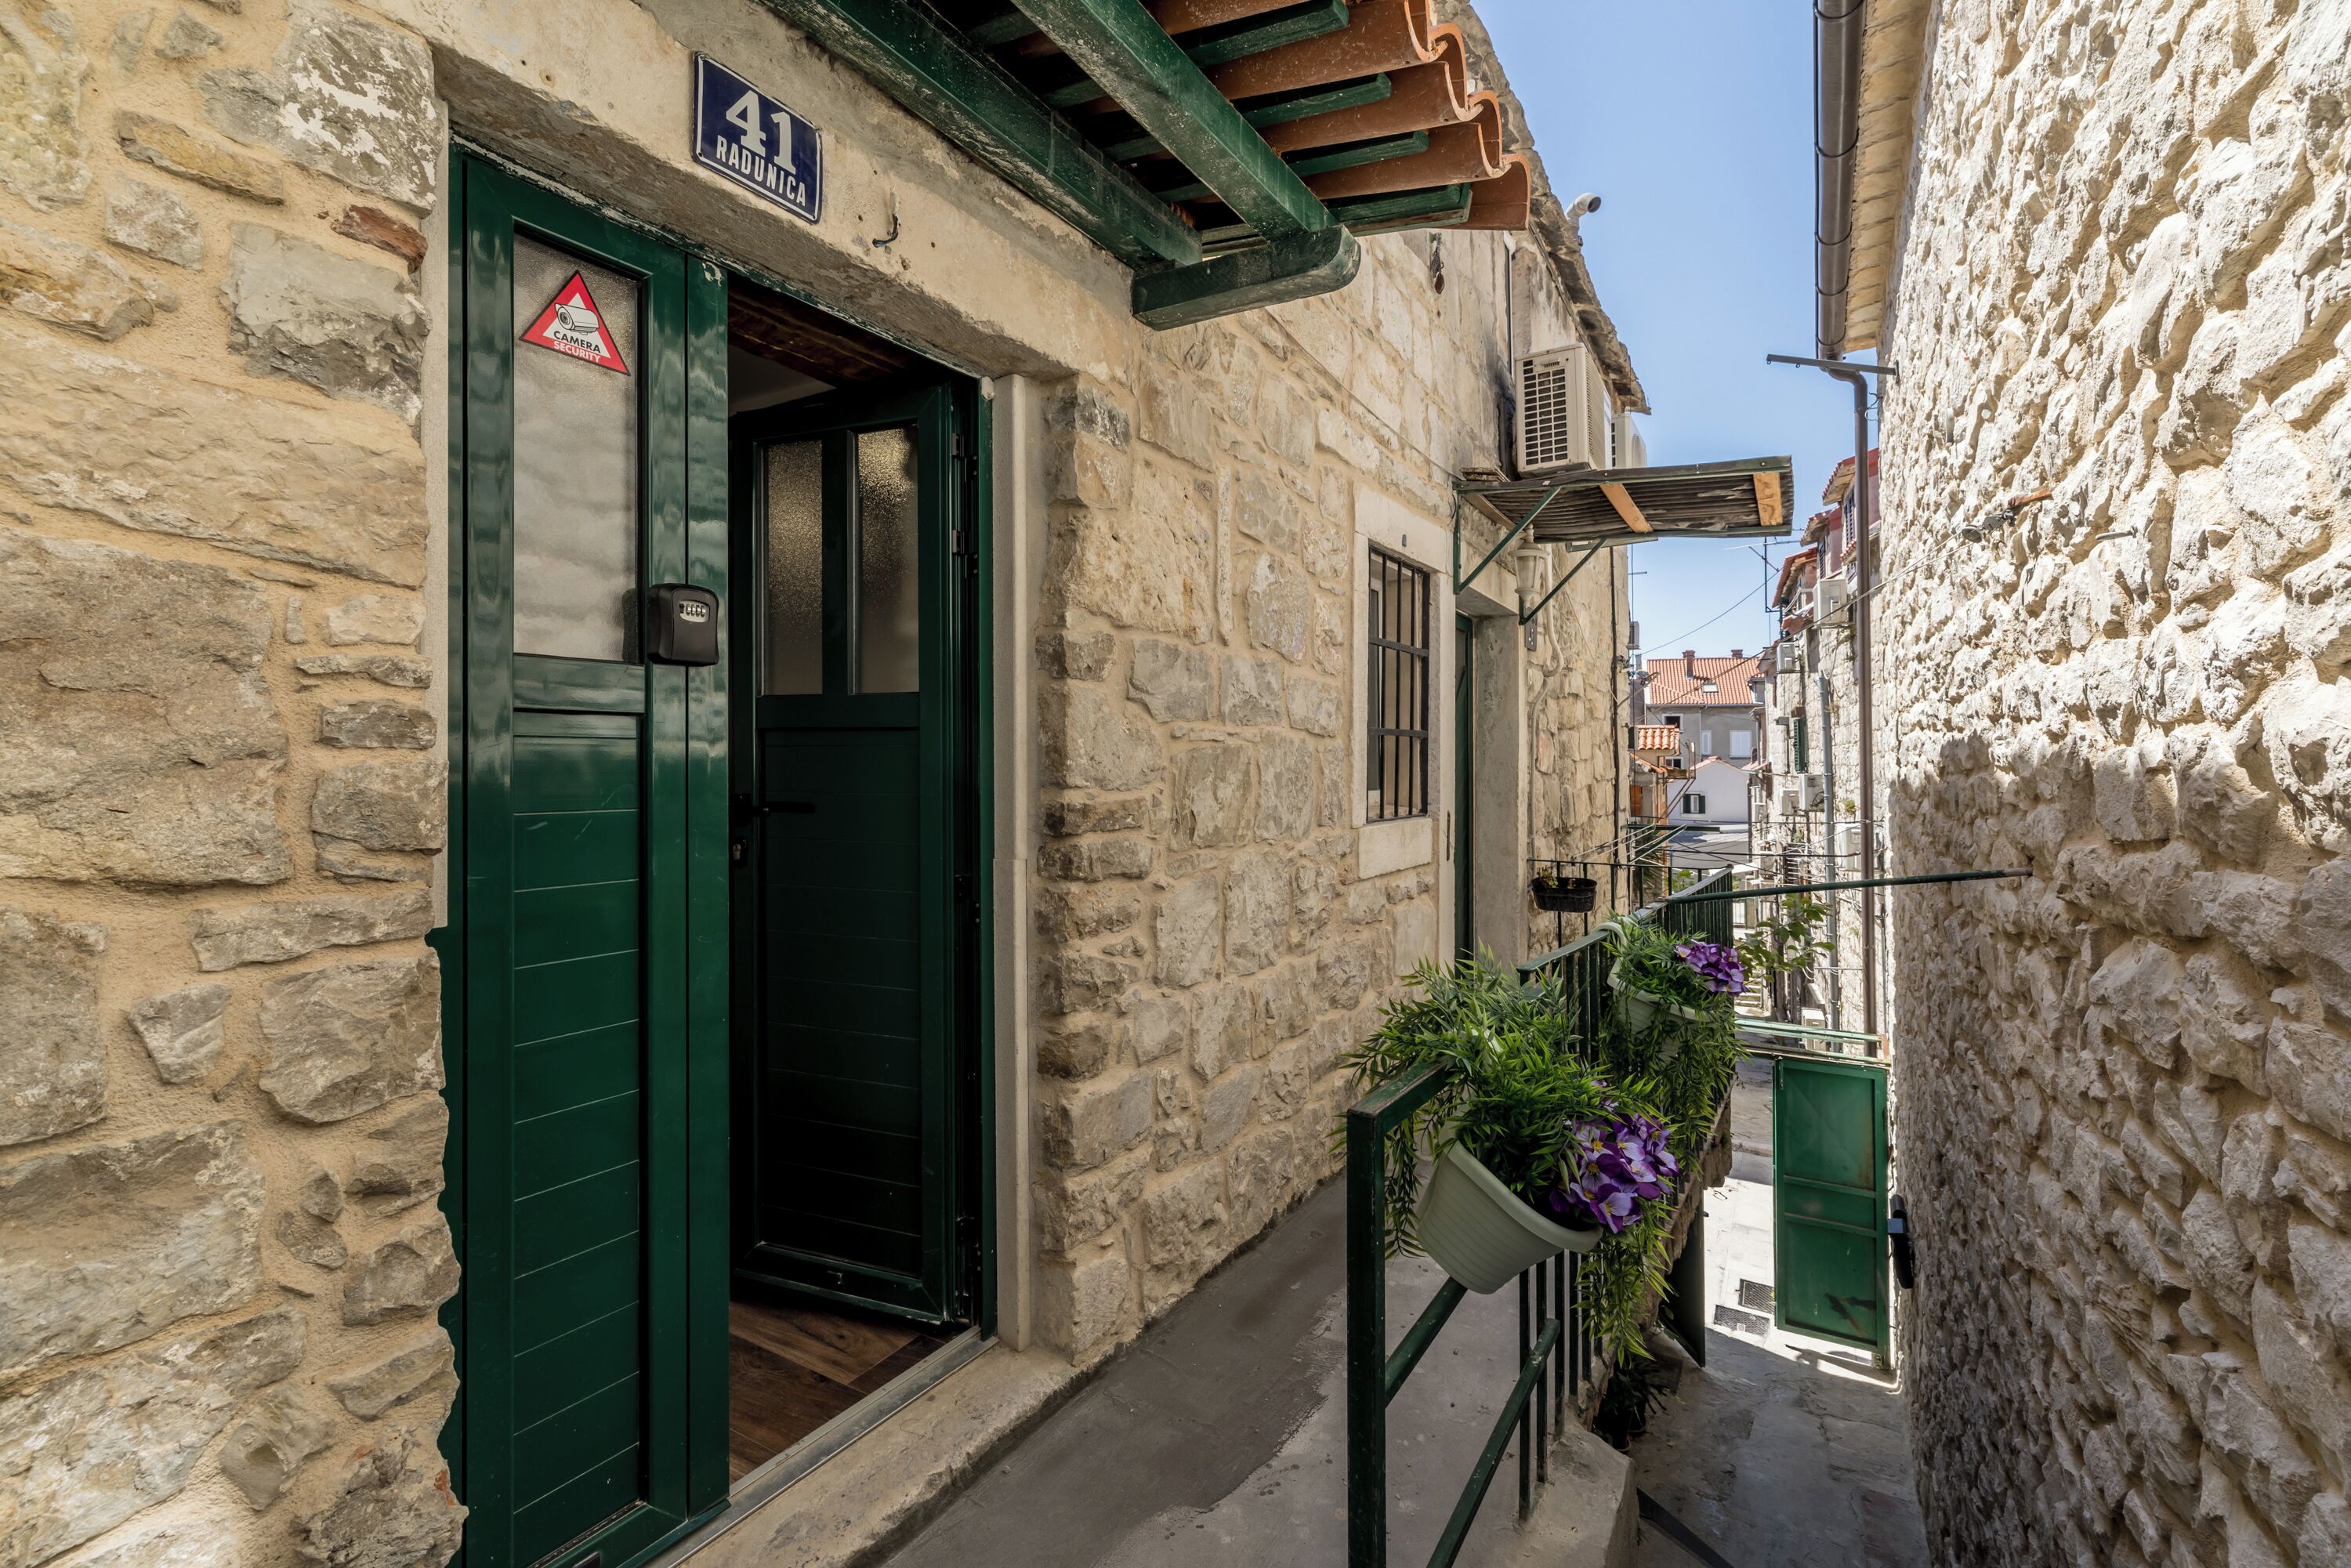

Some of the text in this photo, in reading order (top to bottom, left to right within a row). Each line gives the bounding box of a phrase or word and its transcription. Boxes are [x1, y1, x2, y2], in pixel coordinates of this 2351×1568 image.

[726, 90, 796, 175] 41
[716, 135, 806, 207] RADUNICA
[553, 331, 601, 353] CAMERA
[553, 340, 601, 363] SECURITY
